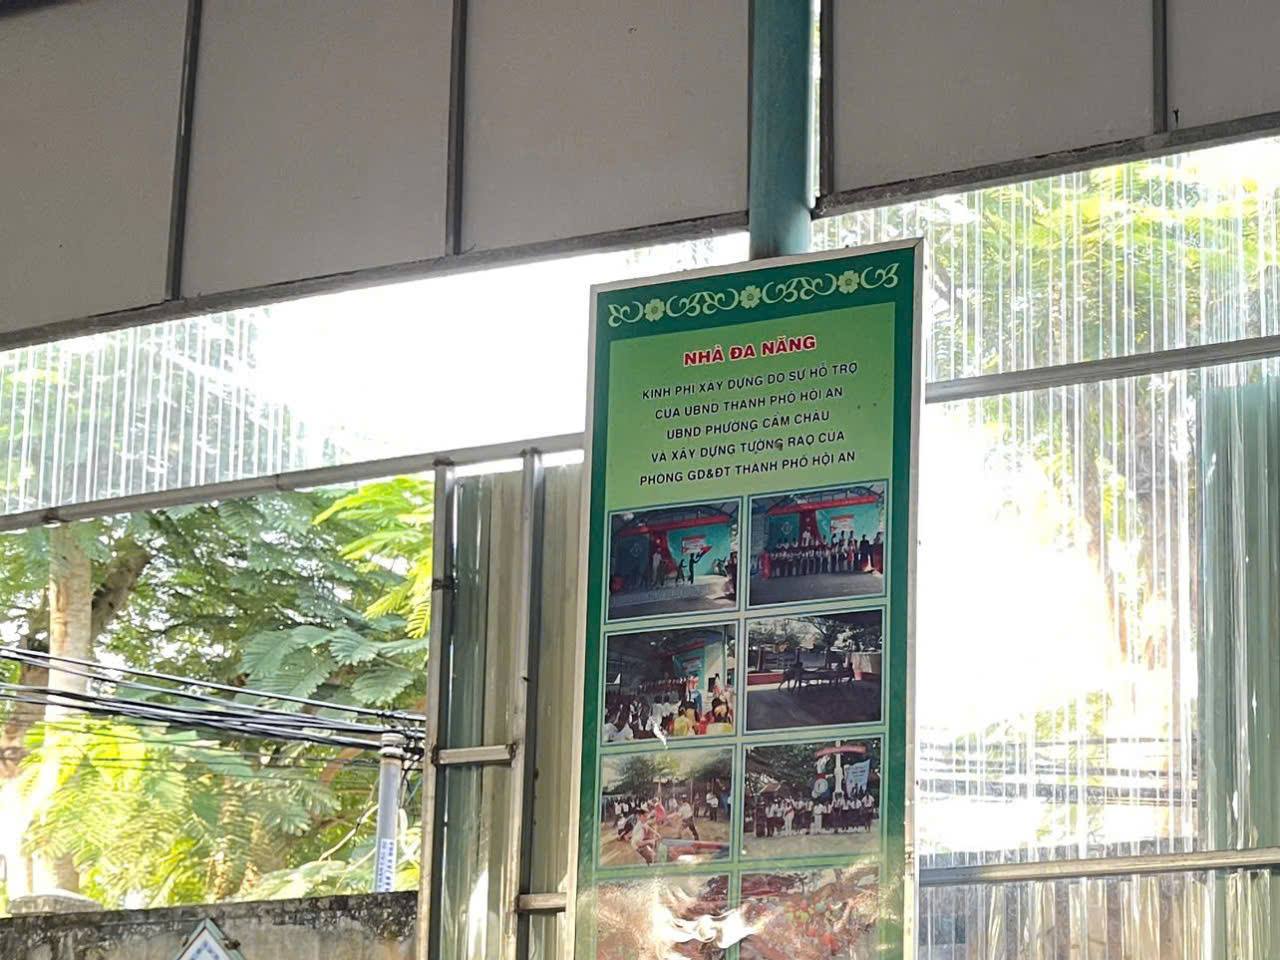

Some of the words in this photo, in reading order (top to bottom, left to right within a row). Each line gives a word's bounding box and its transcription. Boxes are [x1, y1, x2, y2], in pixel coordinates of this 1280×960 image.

[683, 344, 723, 367] NHÀ
[729, 346, 756, 362] ĐA
[761, 335, 817, 358] NĂNG
[642, 385, 671, 399] KINH
[767, 372, 785, 385] DO
[684, 402, 719, 417] UBND
[825, 386, 843, 398] AN
[666, 425, 701, 440] UBND
[671, 446, 696, 461] XÂY
[687, 465, 731, 481] GD&ĐT
[838, 450, 856, 463] AN
